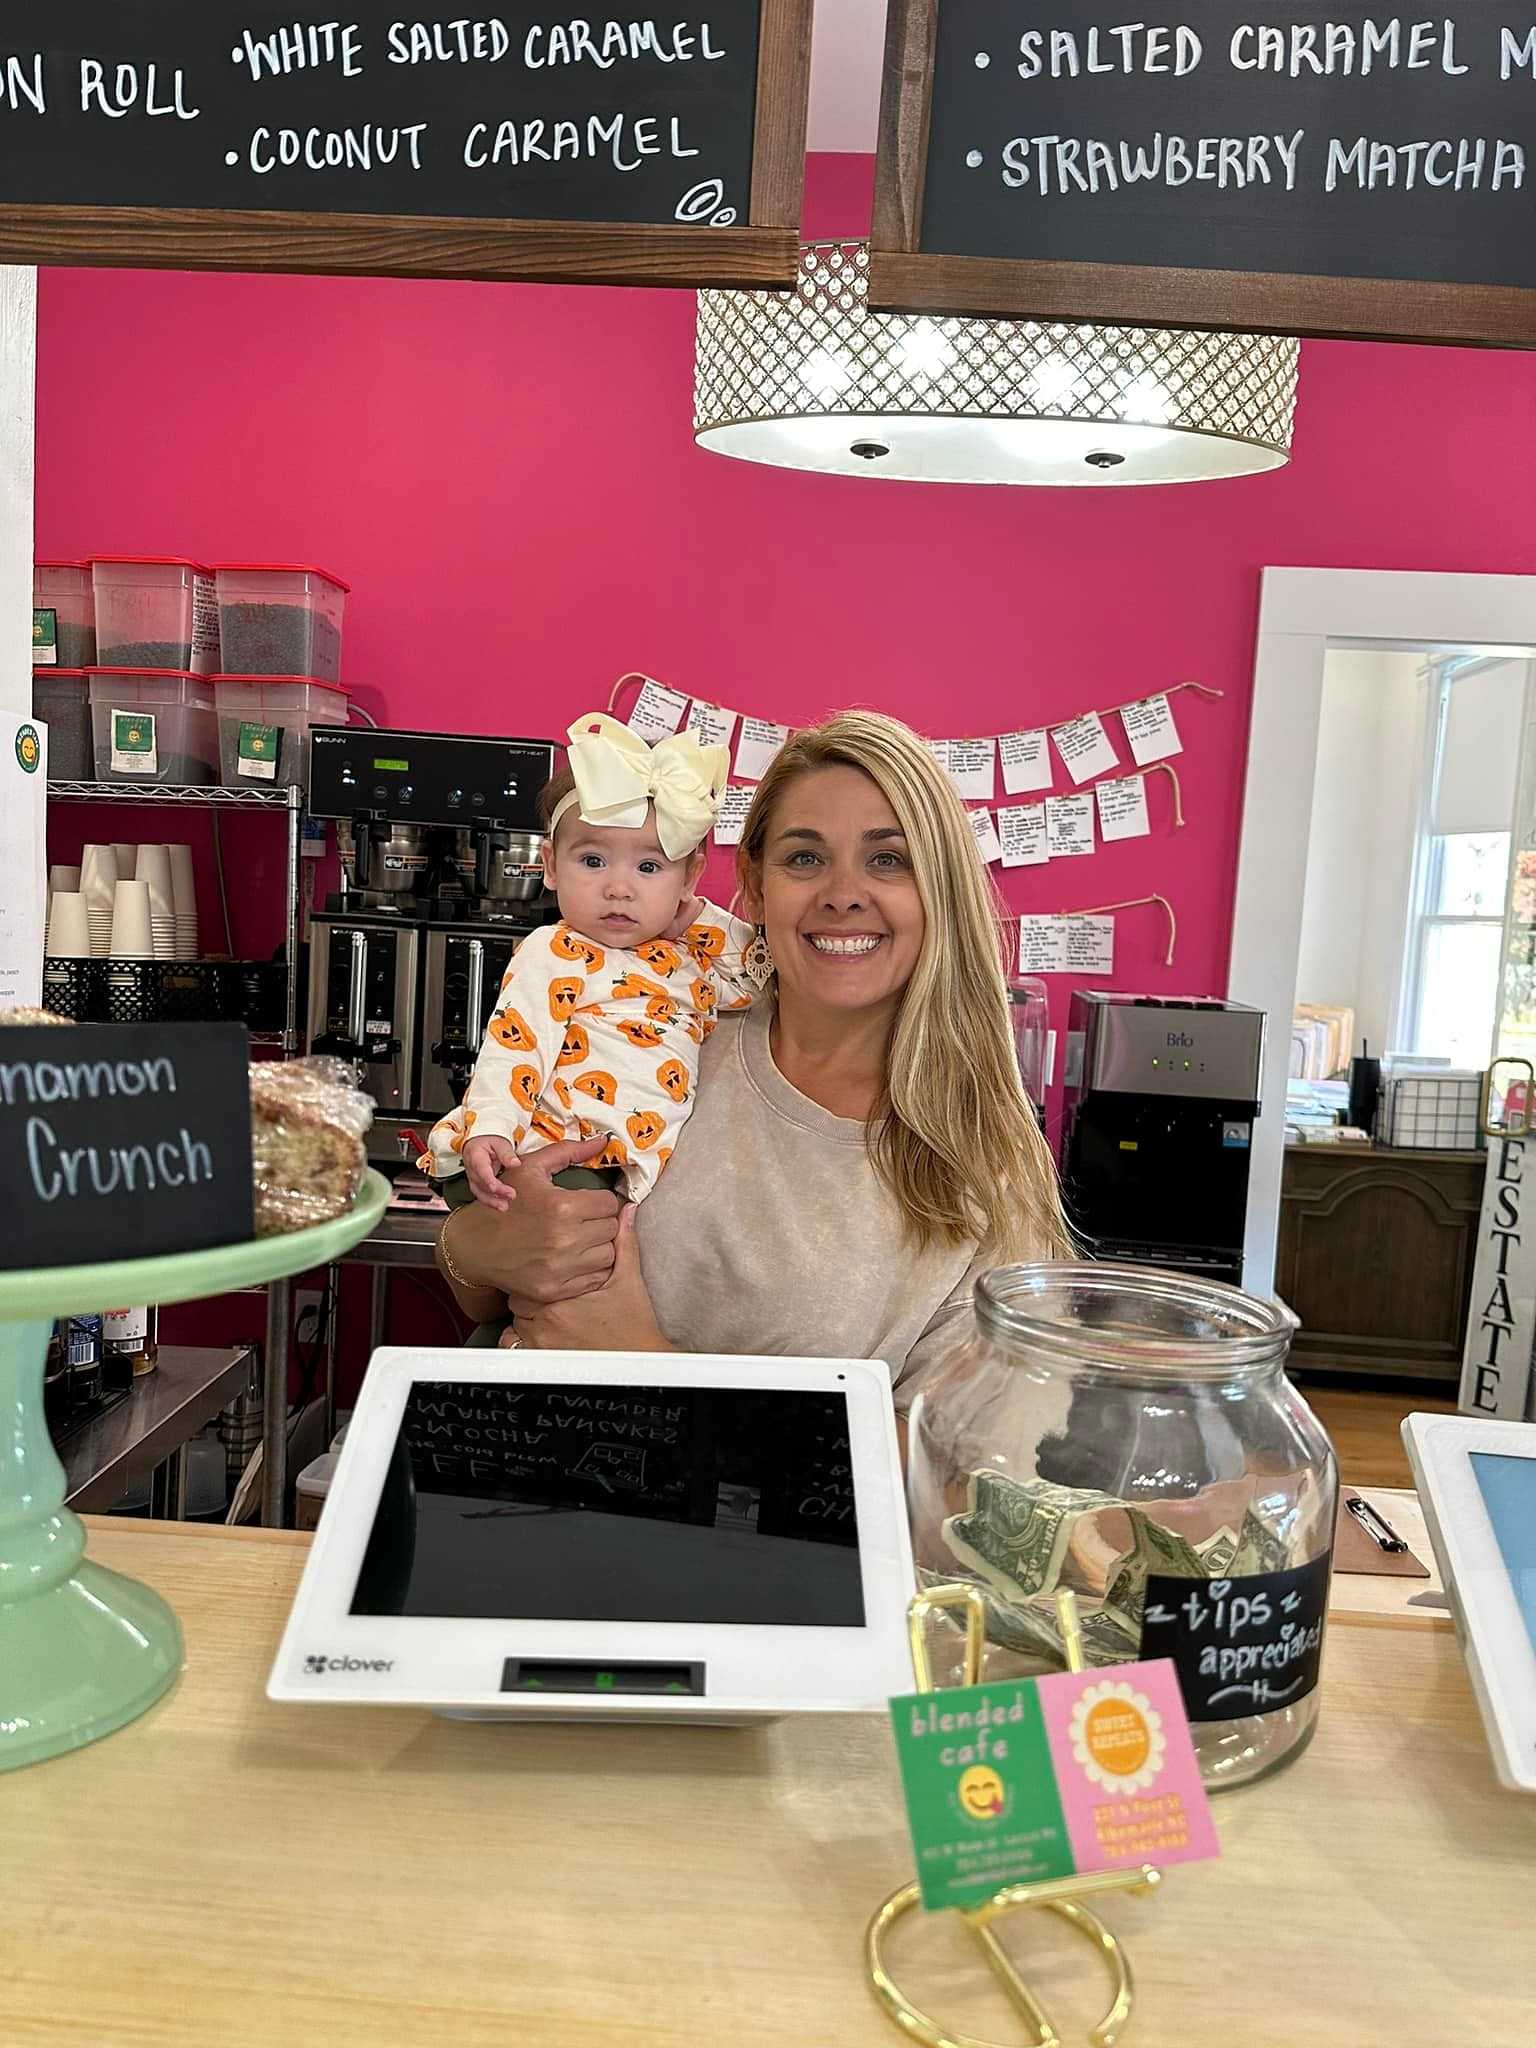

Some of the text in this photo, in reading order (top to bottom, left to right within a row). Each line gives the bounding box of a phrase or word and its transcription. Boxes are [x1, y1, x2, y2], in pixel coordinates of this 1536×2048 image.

[242, 19, 725, 80] WHITE SALTED CARAMEL
[1018, 23, 1202, 79] SALTED
[1230, 19, 1469, 77] CARAMEL
[81, 59, 199, 119] ROLL
[250, 114, 699, 173] COCONUT CARAMEL
[1002, 129, 1525, 195] STRAWBERRY MATCHA
[1167, 1032, 1194, 1048] Brio
[0, 1057, 177, 1105] namon
[26, 1116, 213, 1202] Crunch
[1472, 1139, 1526, 1413] ESTATE
[1182, 1580, 1272, 1638] tips
[328, 1656, 394, 1673] clover
[910, 1691, 1025, 1736] blended
[940, 1728, 1009, 1766] cafe
